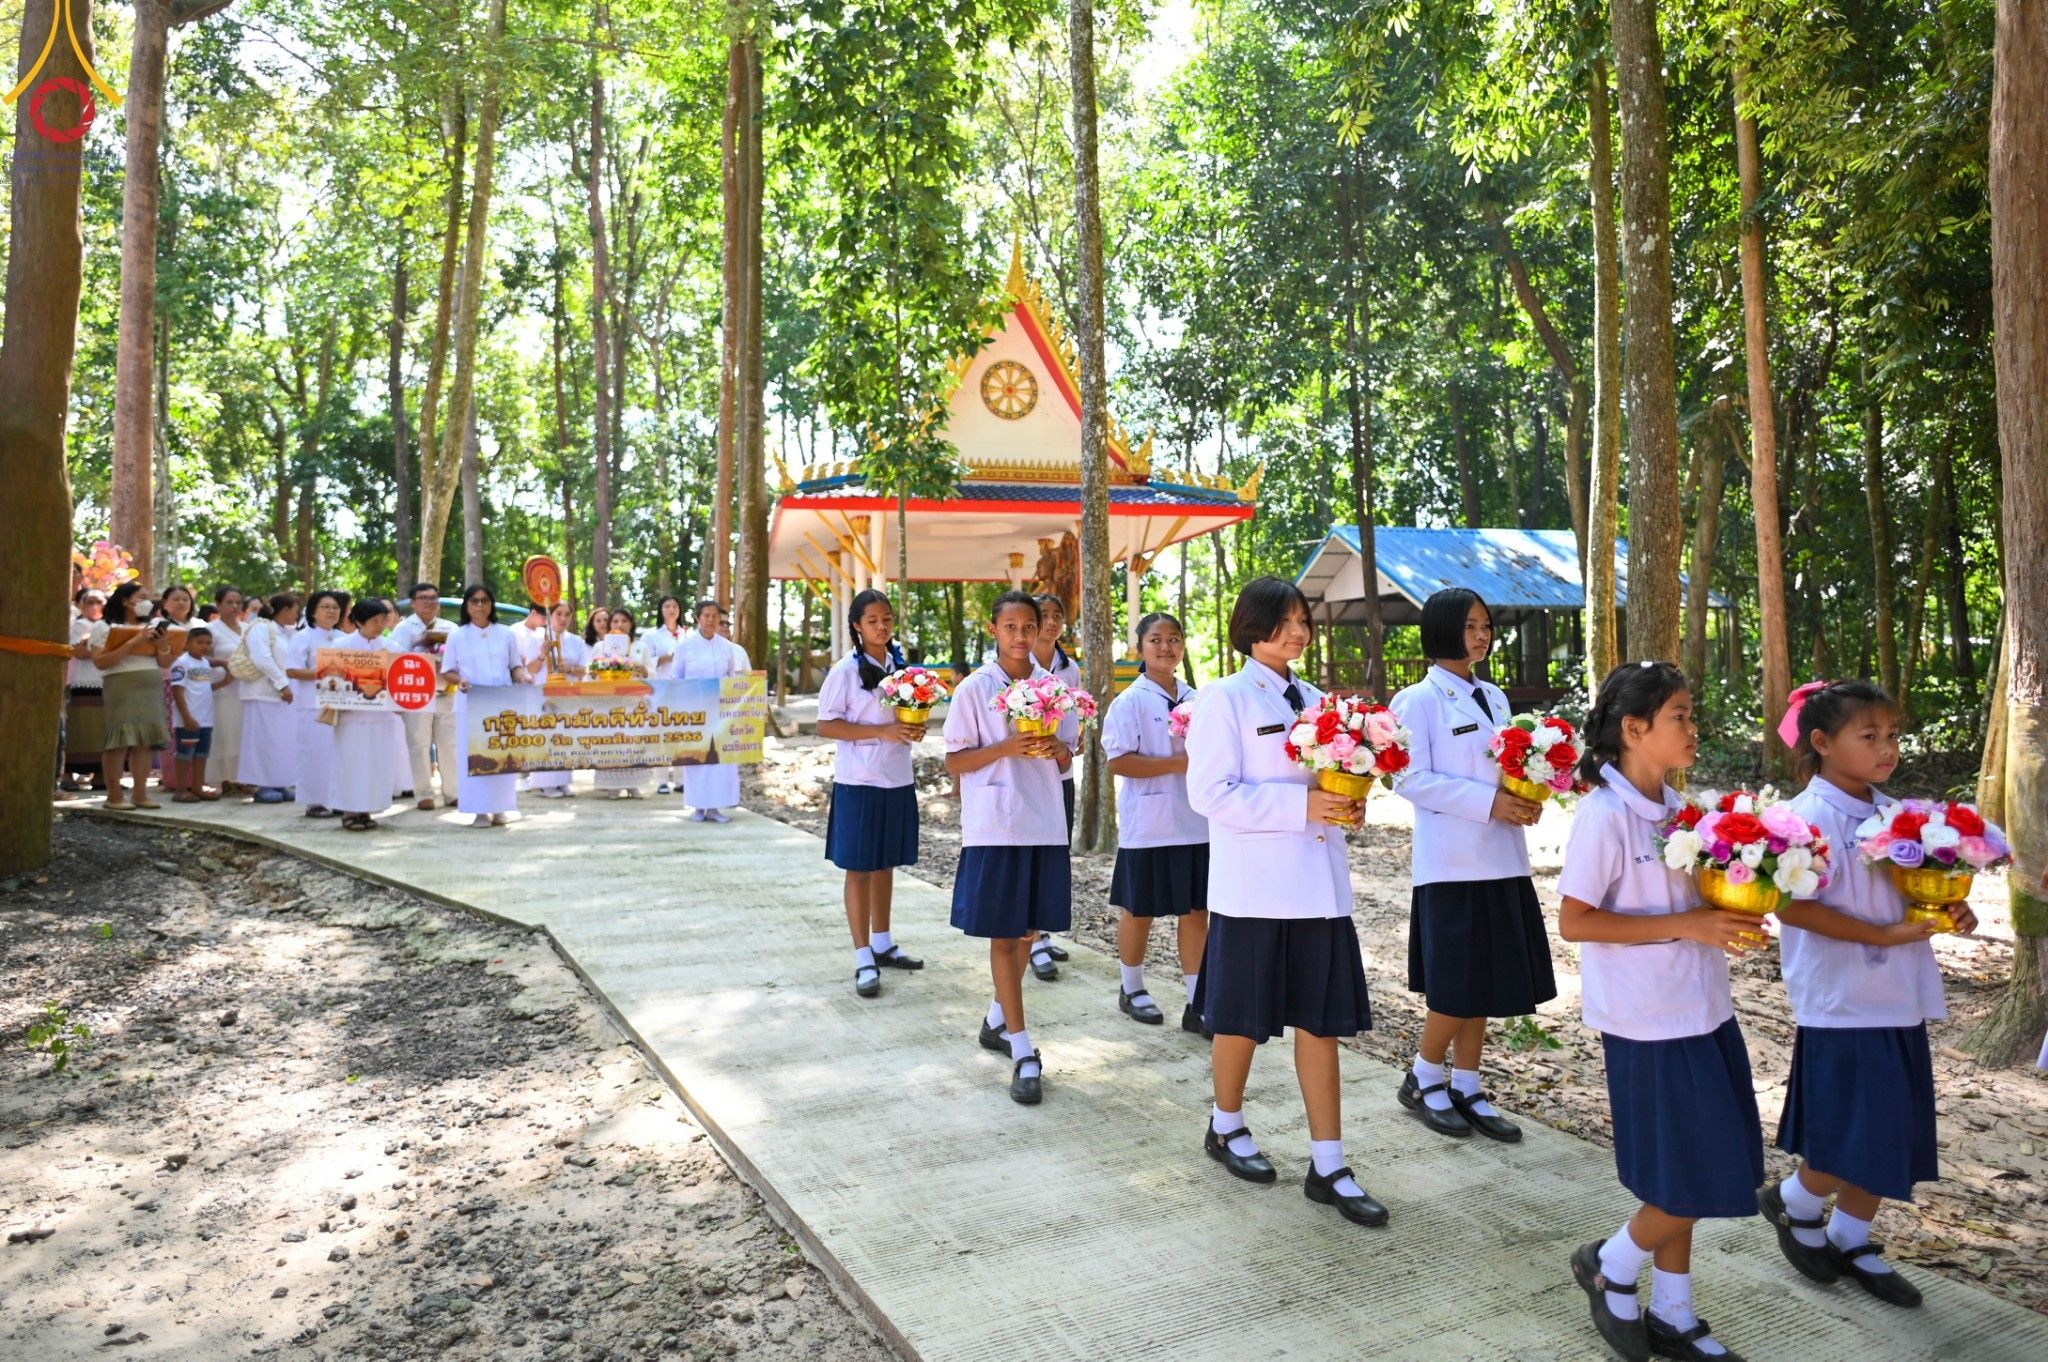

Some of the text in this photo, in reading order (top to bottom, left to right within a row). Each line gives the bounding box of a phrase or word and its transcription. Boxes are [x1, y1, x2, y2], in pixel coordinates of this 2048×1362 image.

[483, 702, 706, 736] กฐินสามัคคีทั่วไทย
[488, 734, 545, 750] 5,000
[663, 731, 703, 744] 2566
